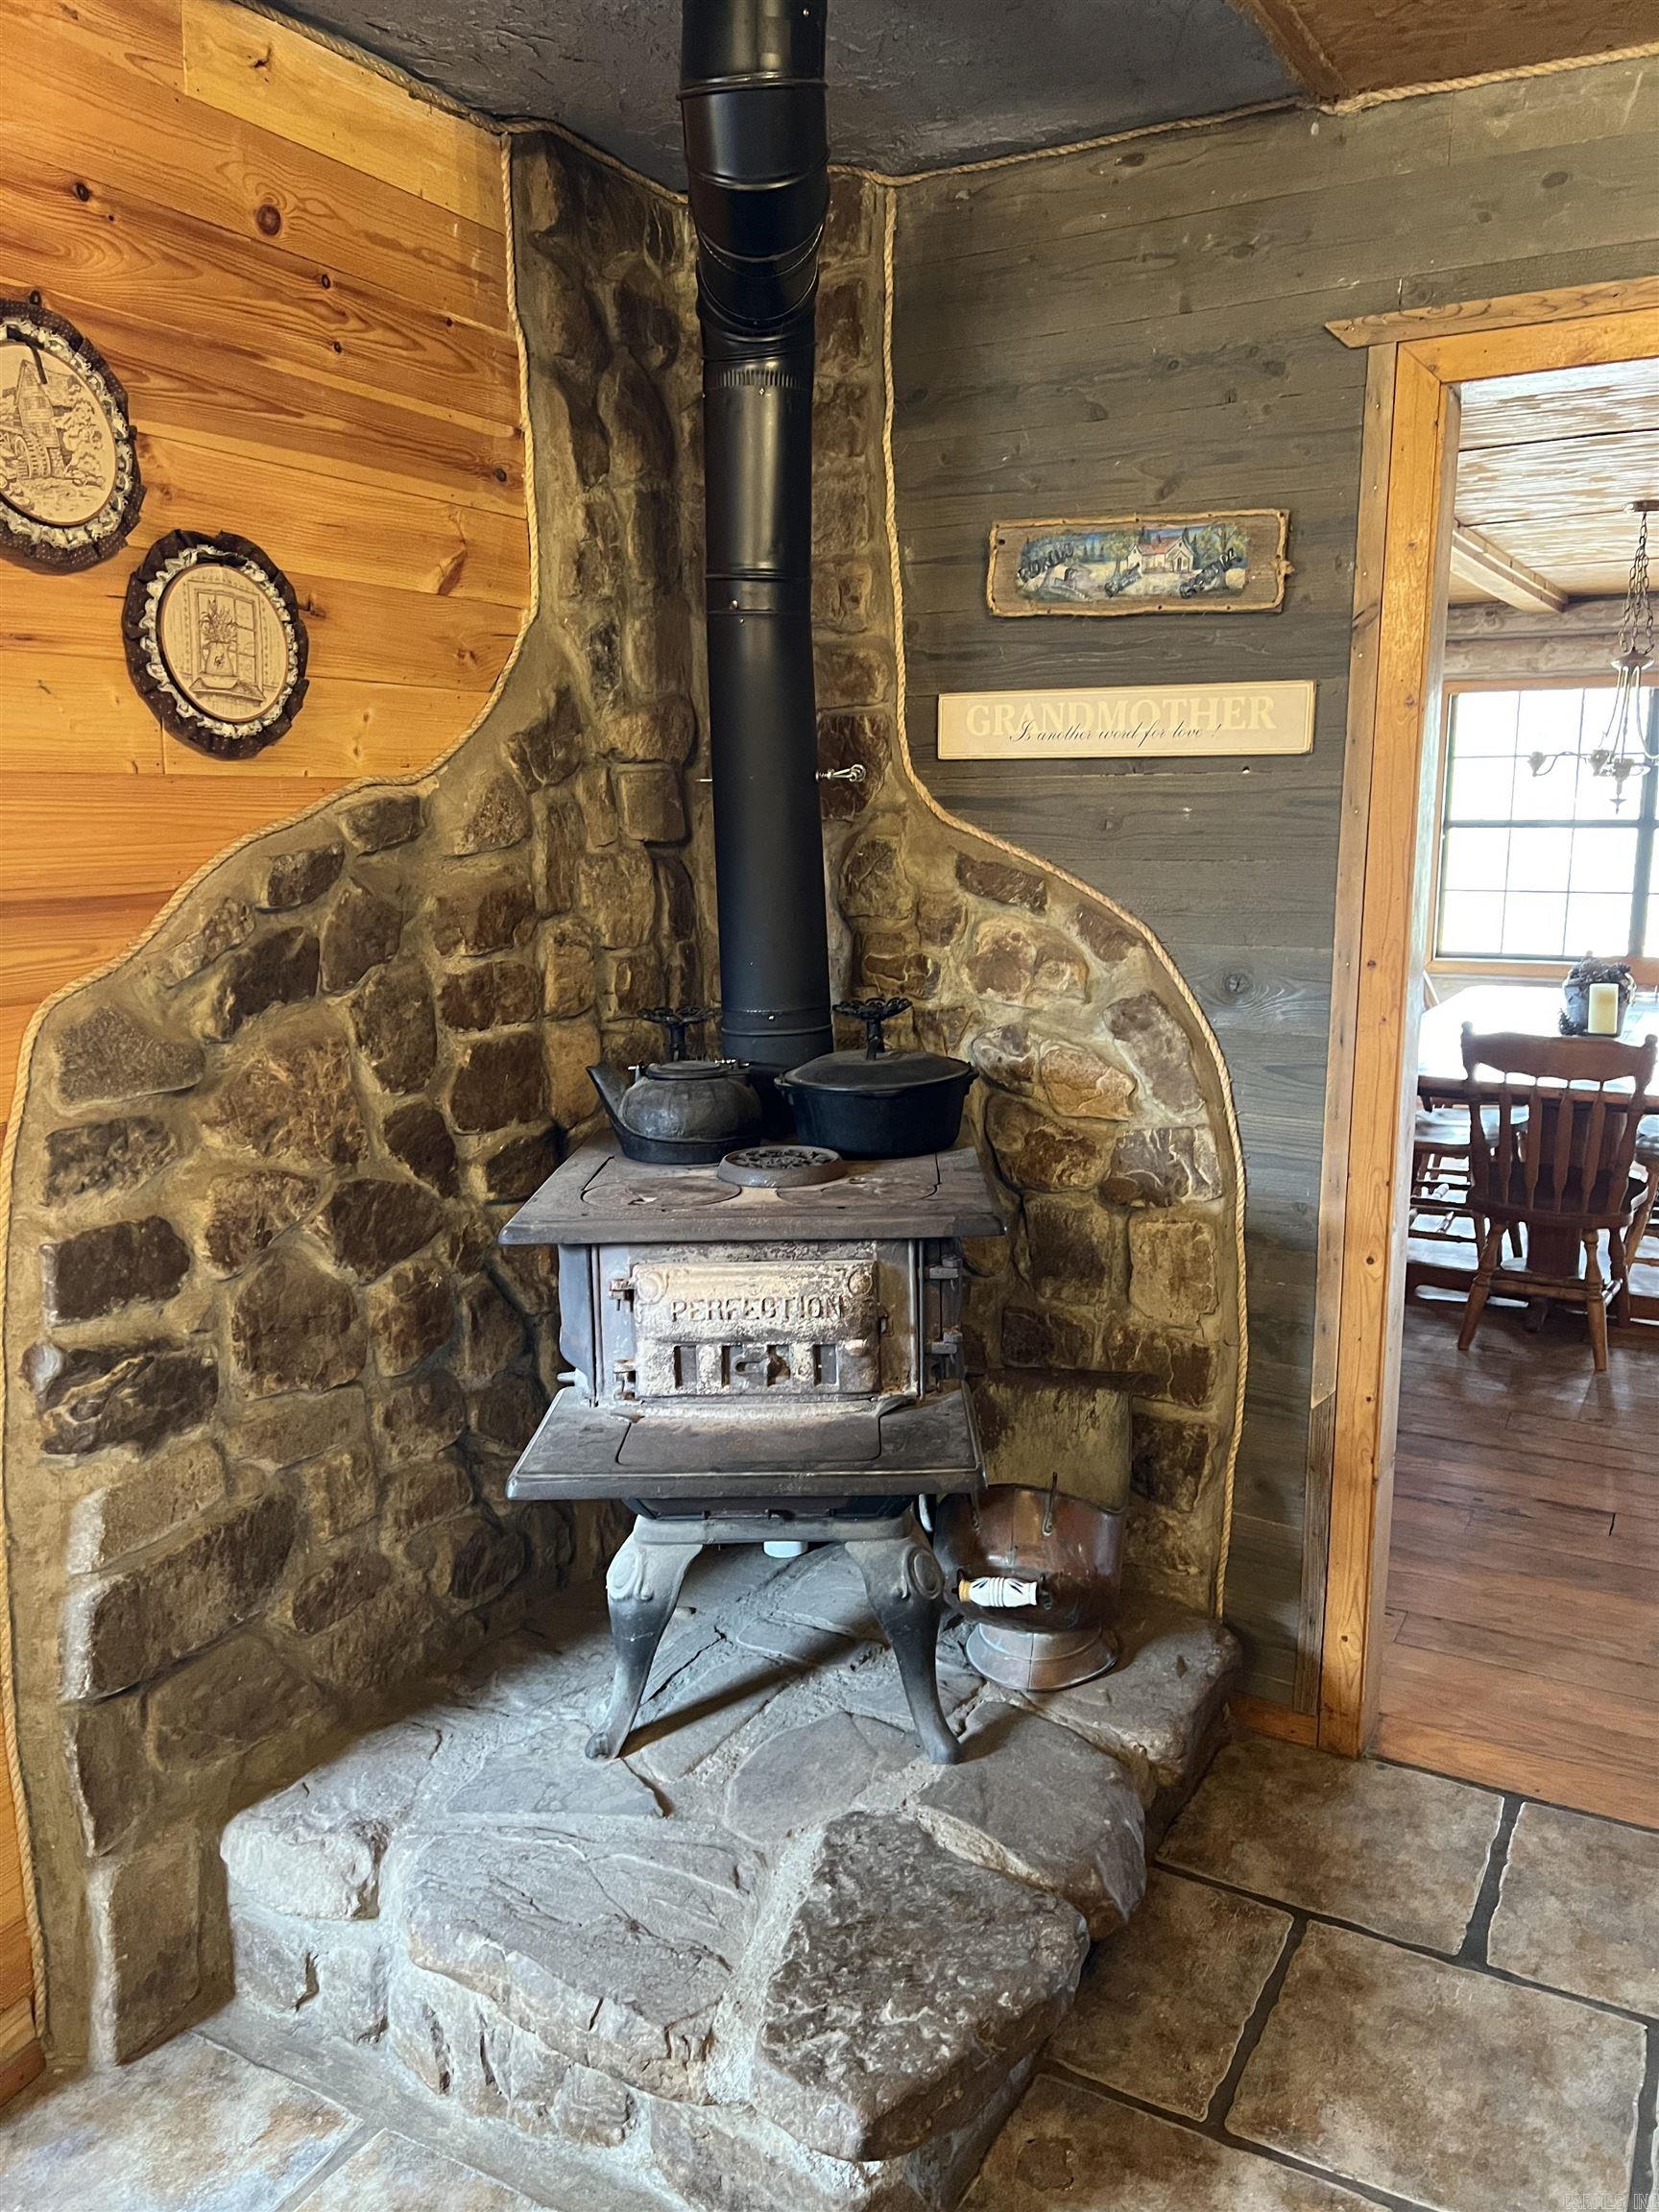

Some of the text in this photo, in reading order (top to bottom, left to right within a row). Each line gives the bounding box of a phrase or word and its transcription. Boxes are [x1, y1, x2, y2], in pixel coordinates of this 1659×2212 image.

[966, 695, 1277, 737] GRANDMOTHER
[1009, 719, 1036, 742] Is
[1037, 722, 1093, 741] another
[1098, 721, 1143, 739] word
[1137, 720, 1166, 749] for
[670, 1294, 845, 1323] PERFECTION
